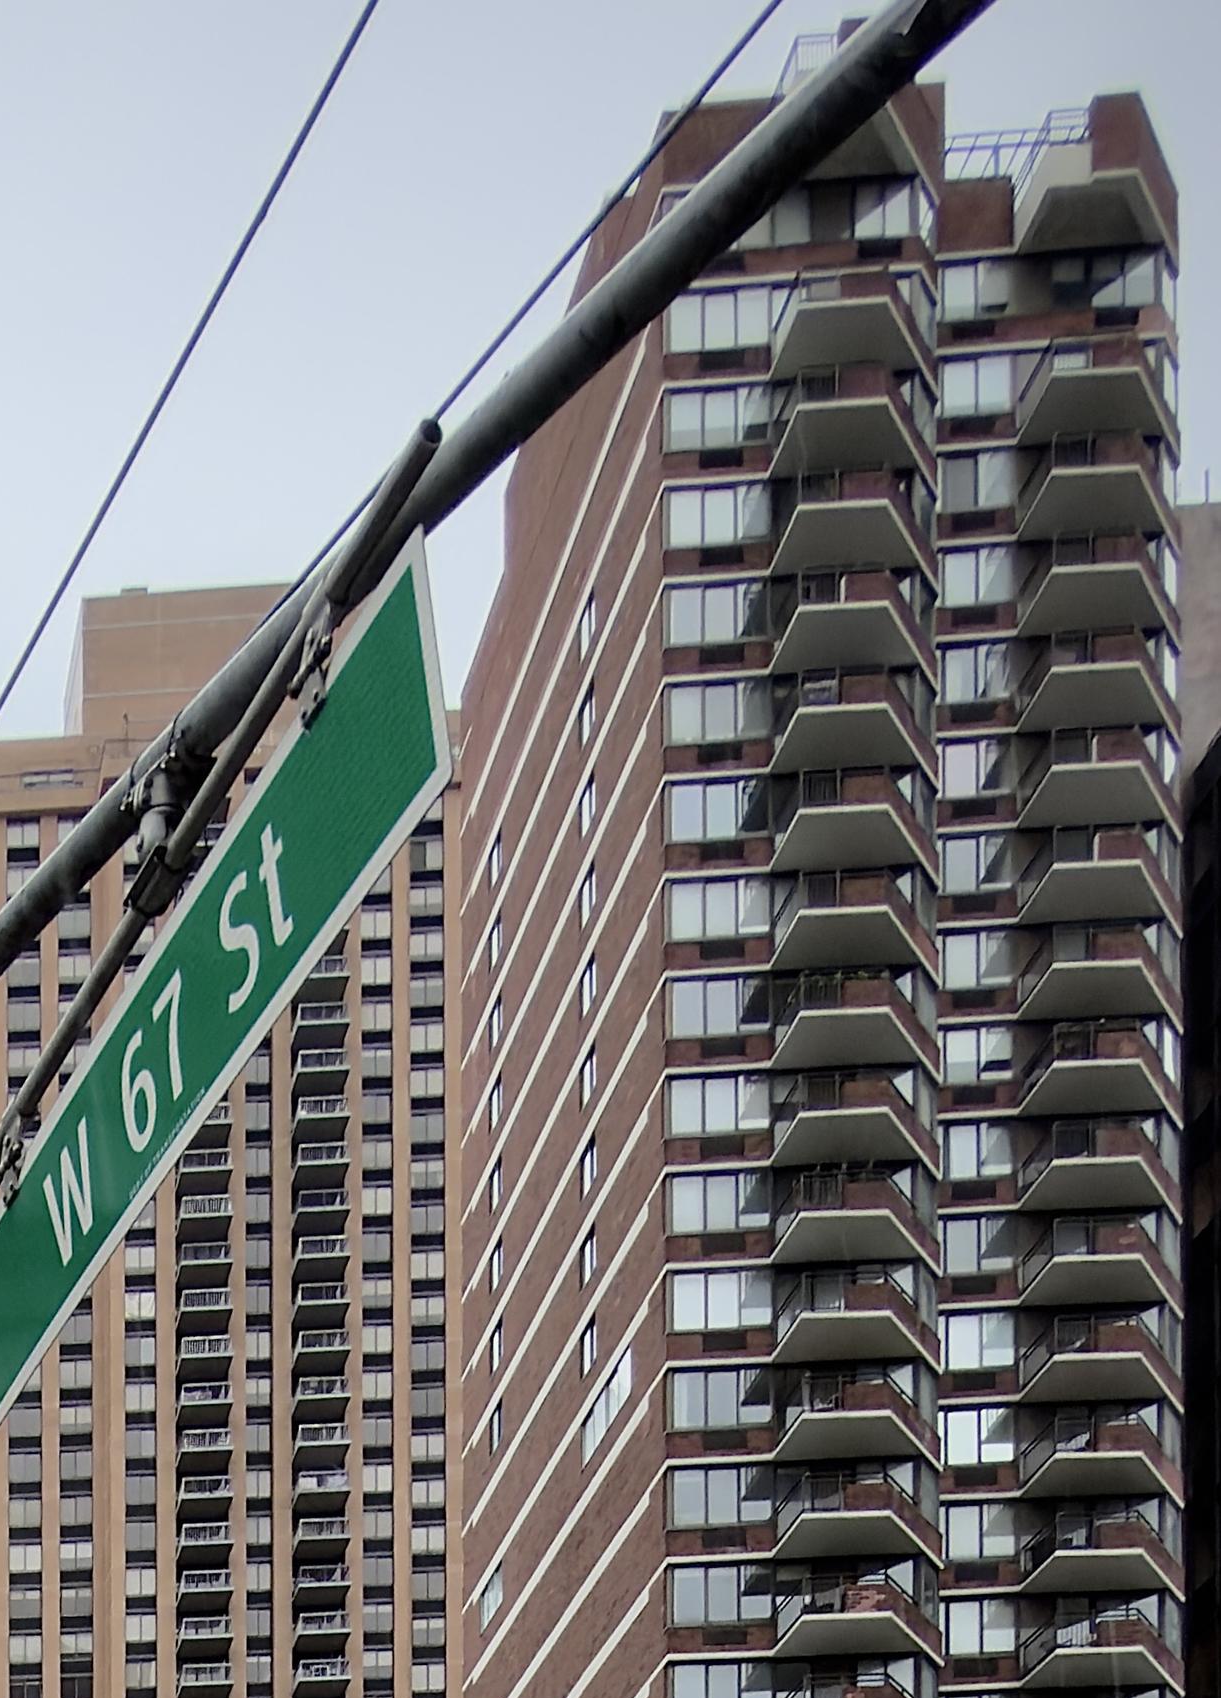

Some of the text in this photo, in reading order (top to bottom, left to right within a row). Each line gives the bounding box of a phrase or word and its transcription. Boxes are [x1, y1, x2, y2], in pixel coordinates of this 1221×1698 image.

[43, 822, 294, 1268] W 67 St
